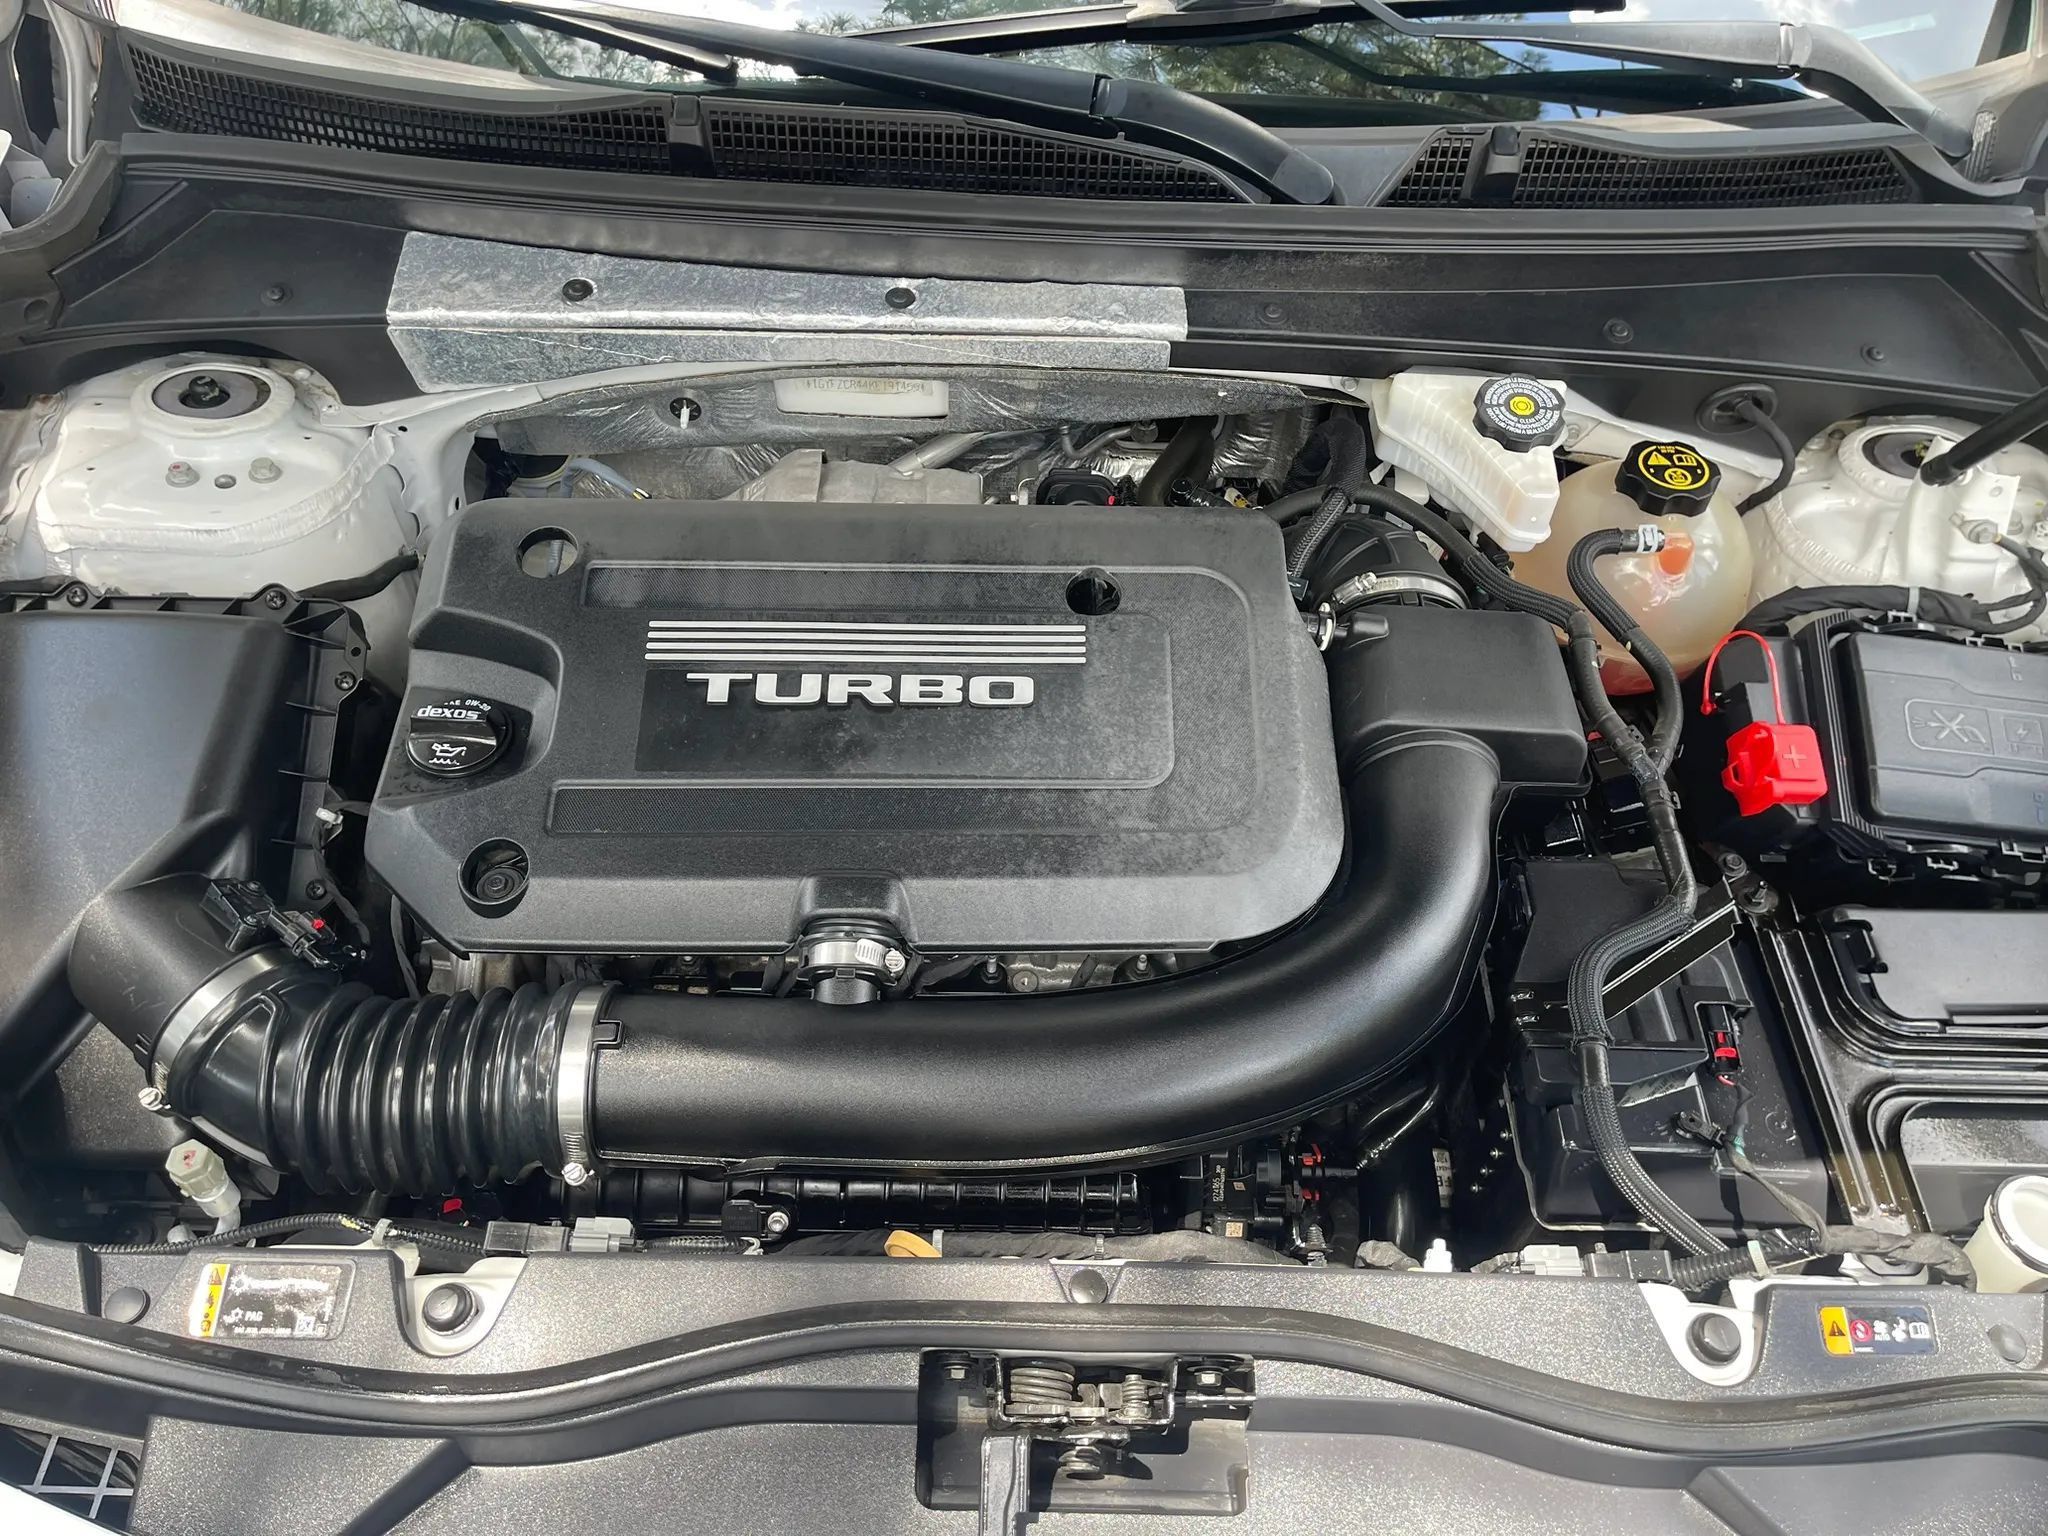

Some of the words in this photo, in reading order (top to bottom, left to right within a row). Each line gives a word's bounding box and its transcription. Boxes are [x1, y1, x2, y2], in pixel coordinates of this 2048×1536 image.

[686, 673, 1035, 706] TURBO
[417, 705, 482, 720] dexos
[244, 1310, 264, 1322] PAG
